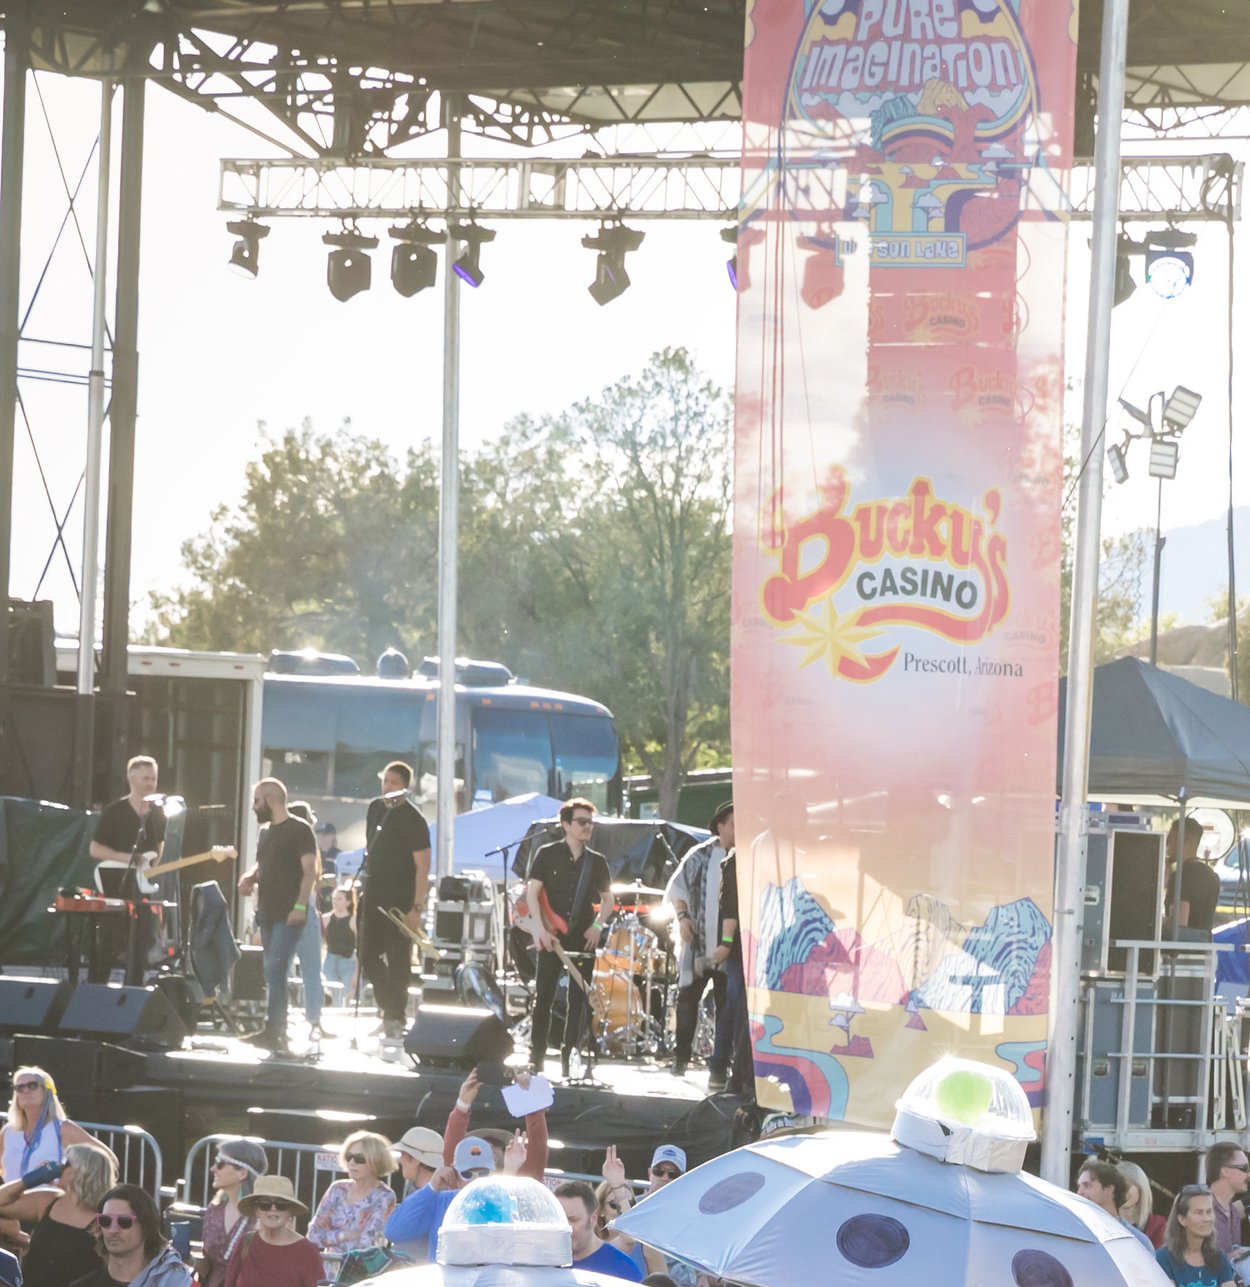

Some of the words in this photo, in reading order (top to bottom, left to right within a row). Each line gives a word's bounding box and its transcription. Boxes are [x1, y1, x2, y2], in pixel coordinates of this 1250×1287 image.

[801, 41, 1018, 89] IMAGINATION
[759, 463, 1012, 645] Bucky's
[855, 566, 978, 610] CASINO
[903, 652, 972, 675] Prescott,
[974, 656, 1024, 678] Arizona
